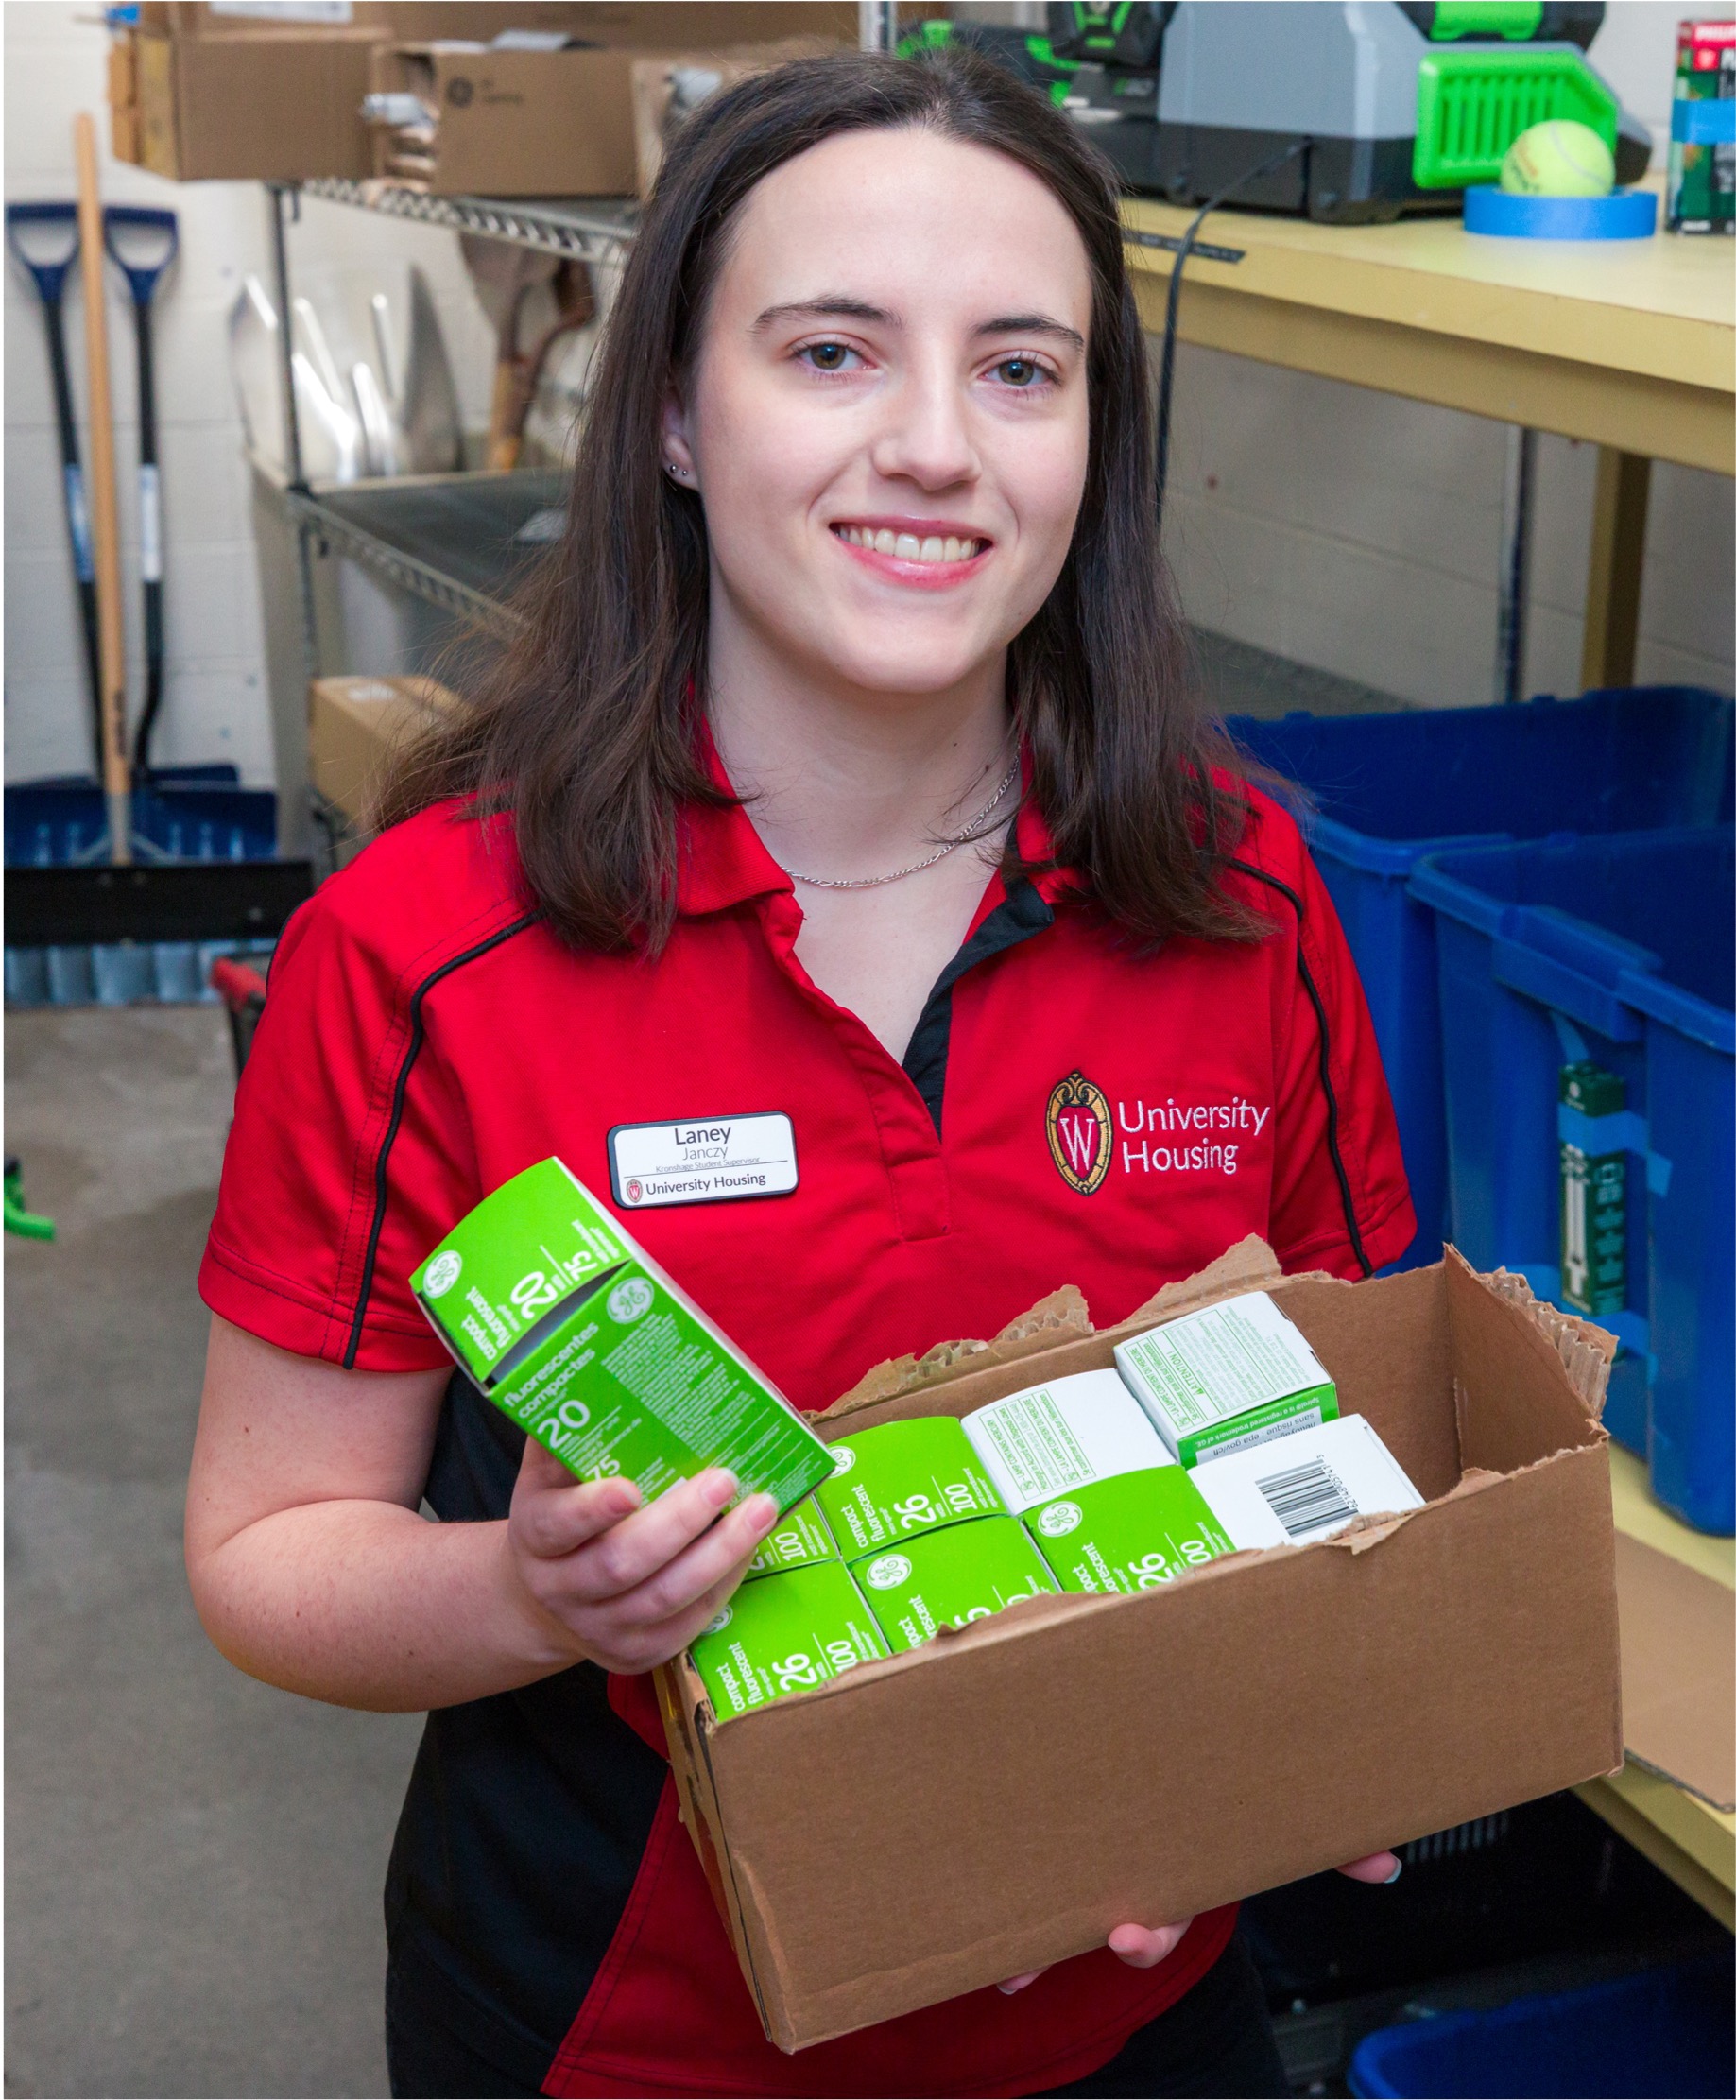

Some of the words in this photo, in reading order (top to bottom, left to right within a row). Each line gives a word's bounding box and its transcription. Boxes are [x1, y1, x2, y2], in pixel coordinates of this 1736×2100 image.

[1119, 1096, 1271, 1136] University
[675, 1127, 731, 1145] Laney
[1059, 1114, 1095, 1170] W
[656, 1161, 694, 1173] Kronshage
[695, 1159, 722, 1170] Student
[723, 1156, 761, 1168] Supervisor
[682, 1146, 728, 1161] Janczy
[1123, 1137, 1239, 1175] Housing
[645, 1179, 710, 1195] University
[713, 1173, 766, 1188] Housing
[562, 1250, 598, 1282] 75
[509, 1270, 559, 1320] 20
[464, 1285, 512, 1350] fluorescent
[460, 1314, 501, 1362] compact
[503, 1321, 600, 1408] fluorescentes
[1128, 1348, 1147, 1368] MERCURE
[1170, 1353, 1202, 1389] ATTENTION
[518, 1348, 596, 1421] compactes
[1147, 1374, 1166, 1395] CONTIENT
[536, 1399, 591, 1450] 20
[1023, 1399, 1040, 1420] MERCURE
[1250, 1411, 1282, 1428] registered
[1295, 1413, 1315, 1424] sans
[987, 1420, 1004, 1442] MERCURY
[1038, 1425, 1057, 1448] CONTIENT
[1215, 1423, 1249, 1441] trademark
[1266, 1420, 1292, 1435] risque
[585, 1455, 621, 1481] 75
[998, 1440, 1017, 1465] CONTAINS
[1051, 1446, 1066, 1461] LAMPE
[1011, 1465, 1024, 1476] LAMP
[851, 1483, 886, 1542] fluorescent
[893, 1494, 937, 1530] 26
[943, 1483, 978, 1514] 100
[840, 1503, 875, 1549] compact
[774, 1531, 808, 1562] 100
[1181, 1541, 1212, 1565] 00
[1128, 1554, 1179, 1590] 26
[909, 1595, 937, 1639] rescent
[826, 1641, 858, 1673] 100
[715, 1662, 753, 1713] compact
[728, 1641, 765, 1706] fluorescent
[771, 1653, 818, 1693] 26
